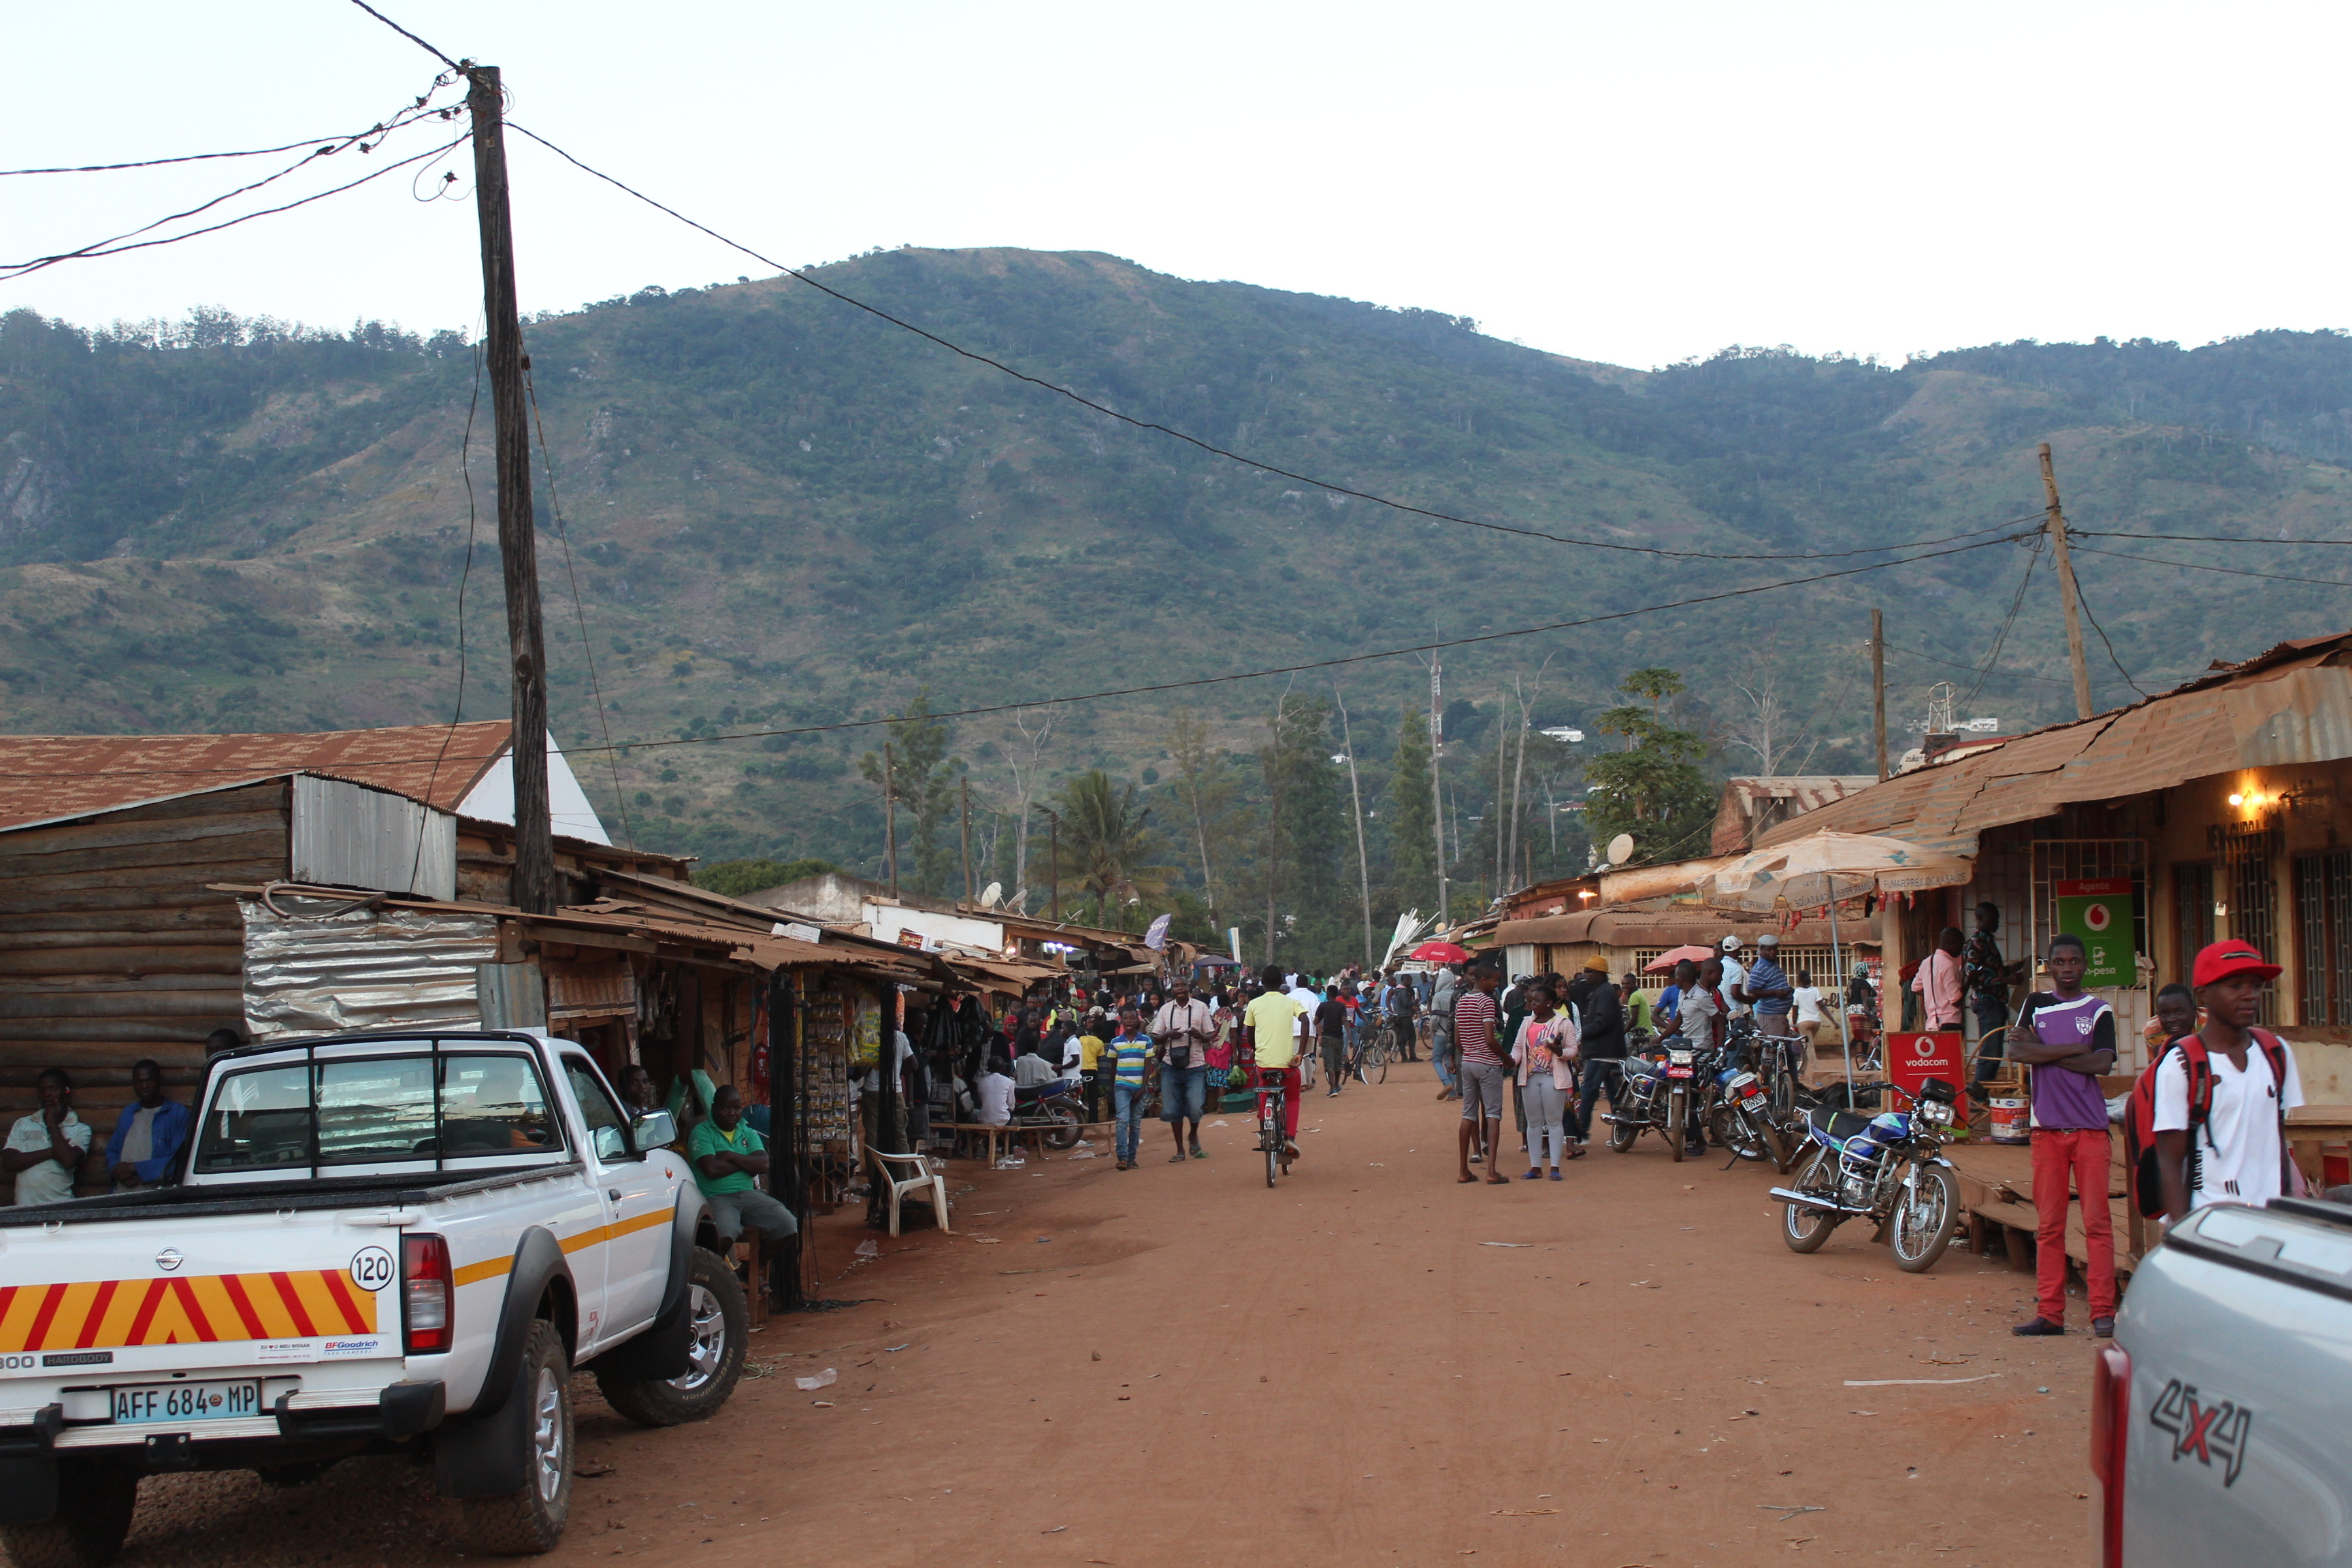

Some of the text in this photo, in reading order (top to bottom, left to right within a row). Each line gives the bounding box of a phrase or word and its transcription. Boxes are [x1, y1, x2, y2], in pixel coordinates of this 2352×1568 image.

[2078, 883, 2110, 893] Agente
[1906, 1058, 1948, 1067] vodacom
[356, 1256, 389, 1281] 120
[694, 1273, 709, 1281] T/A
[325, 1341, 378, 1349] BFGoodrich
[47, 1354, 110, 1365] HARDBODY
[683, 1348, 734, 1401] BFGoodrich
[117, 1385, 255, 1419] AFF 684 MP
